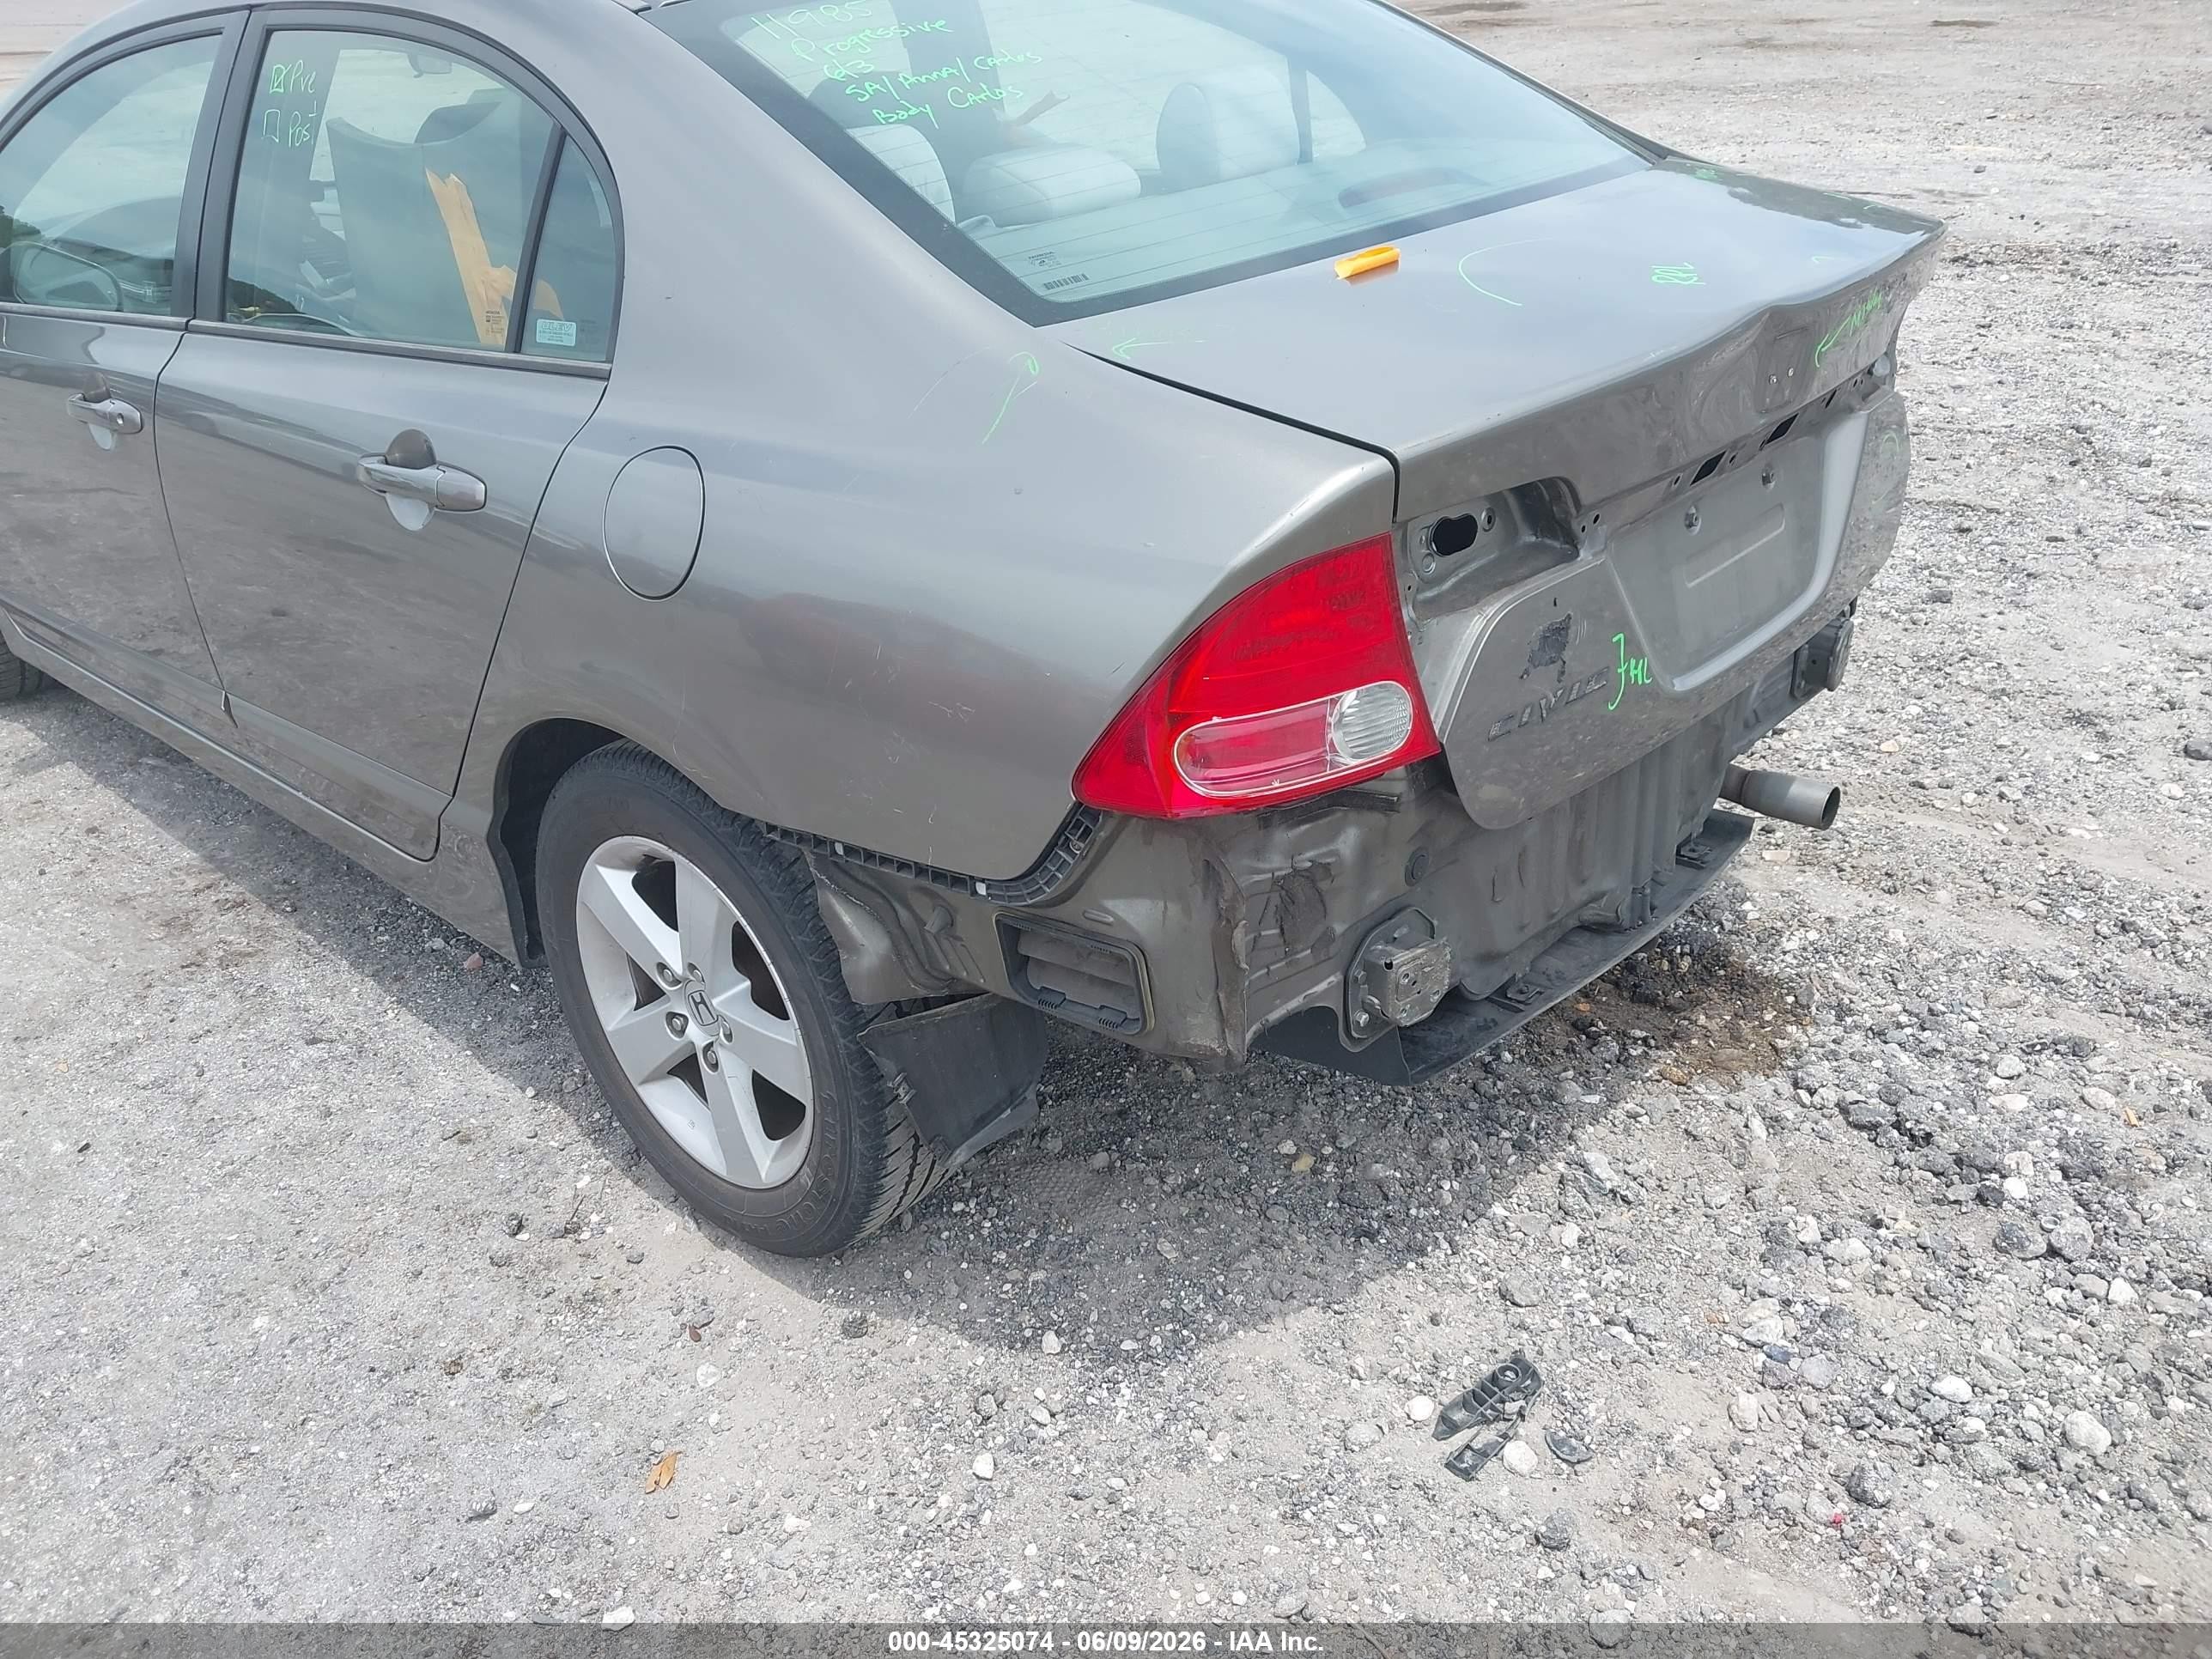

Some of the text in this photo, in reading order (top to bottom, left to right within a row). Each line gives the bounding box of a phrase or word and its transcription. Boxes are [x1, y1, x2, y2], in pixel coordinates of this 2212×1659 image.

[750, 1, 872, 40] 11985
[790, 20, 953, 61] Progressive
[290, 59, 316, 93] Pre
[872, 100, 939, 130] Body
